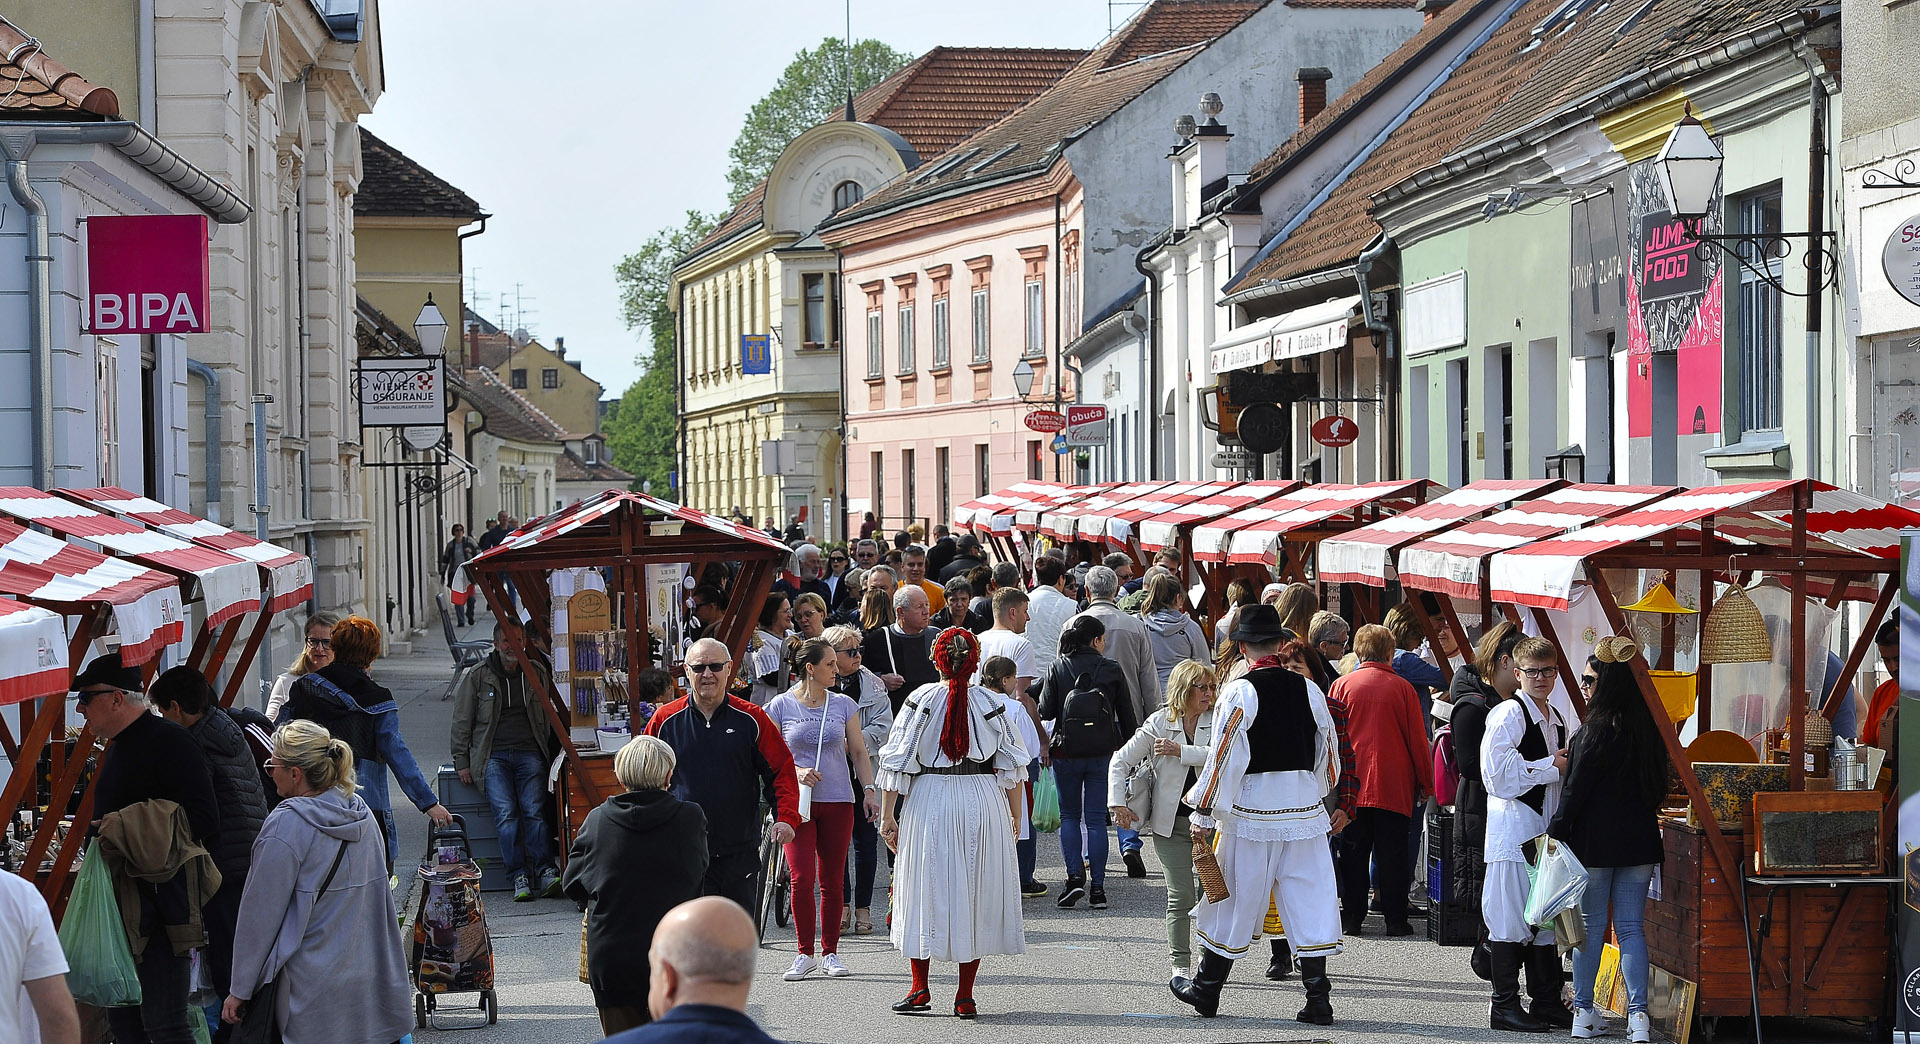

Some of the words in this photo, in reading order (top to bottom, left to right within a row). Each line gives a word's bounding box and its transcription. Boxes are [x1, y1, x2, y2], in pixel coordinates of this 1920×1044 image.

[1643, 253, 1689, 286] FOOD
[95, 292, 199, 330] BIPA
[372, 382, 415, 391] WIENER
[373, 392, 434, 401] OSIGURANJE
[1071, 409, 1103, 422] obuća
